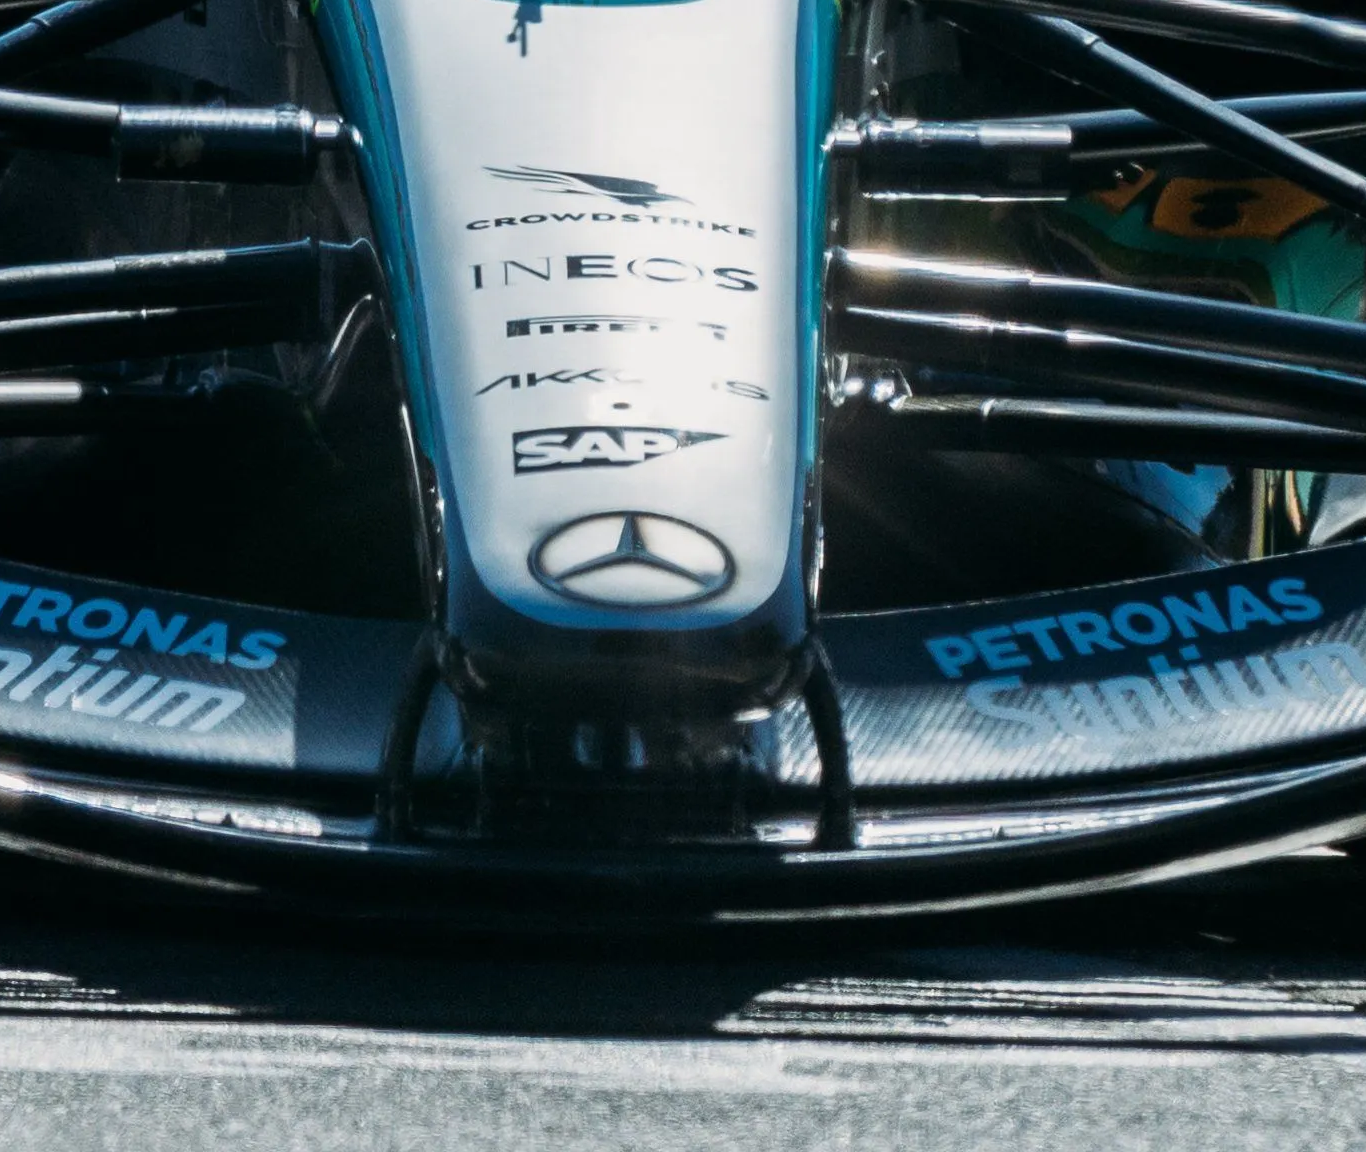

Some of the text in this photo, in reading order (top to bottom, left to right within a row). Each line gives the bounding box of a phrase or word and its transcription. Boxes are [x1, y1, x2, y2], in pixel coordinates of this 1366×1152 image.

[466, 212, 757, 237] CROWDSTRIKE
[469, 254, 760, 292] INEOS
[514, 430, 679, 468] SAP
[924, 577, 1325, 679] PETRONAS
